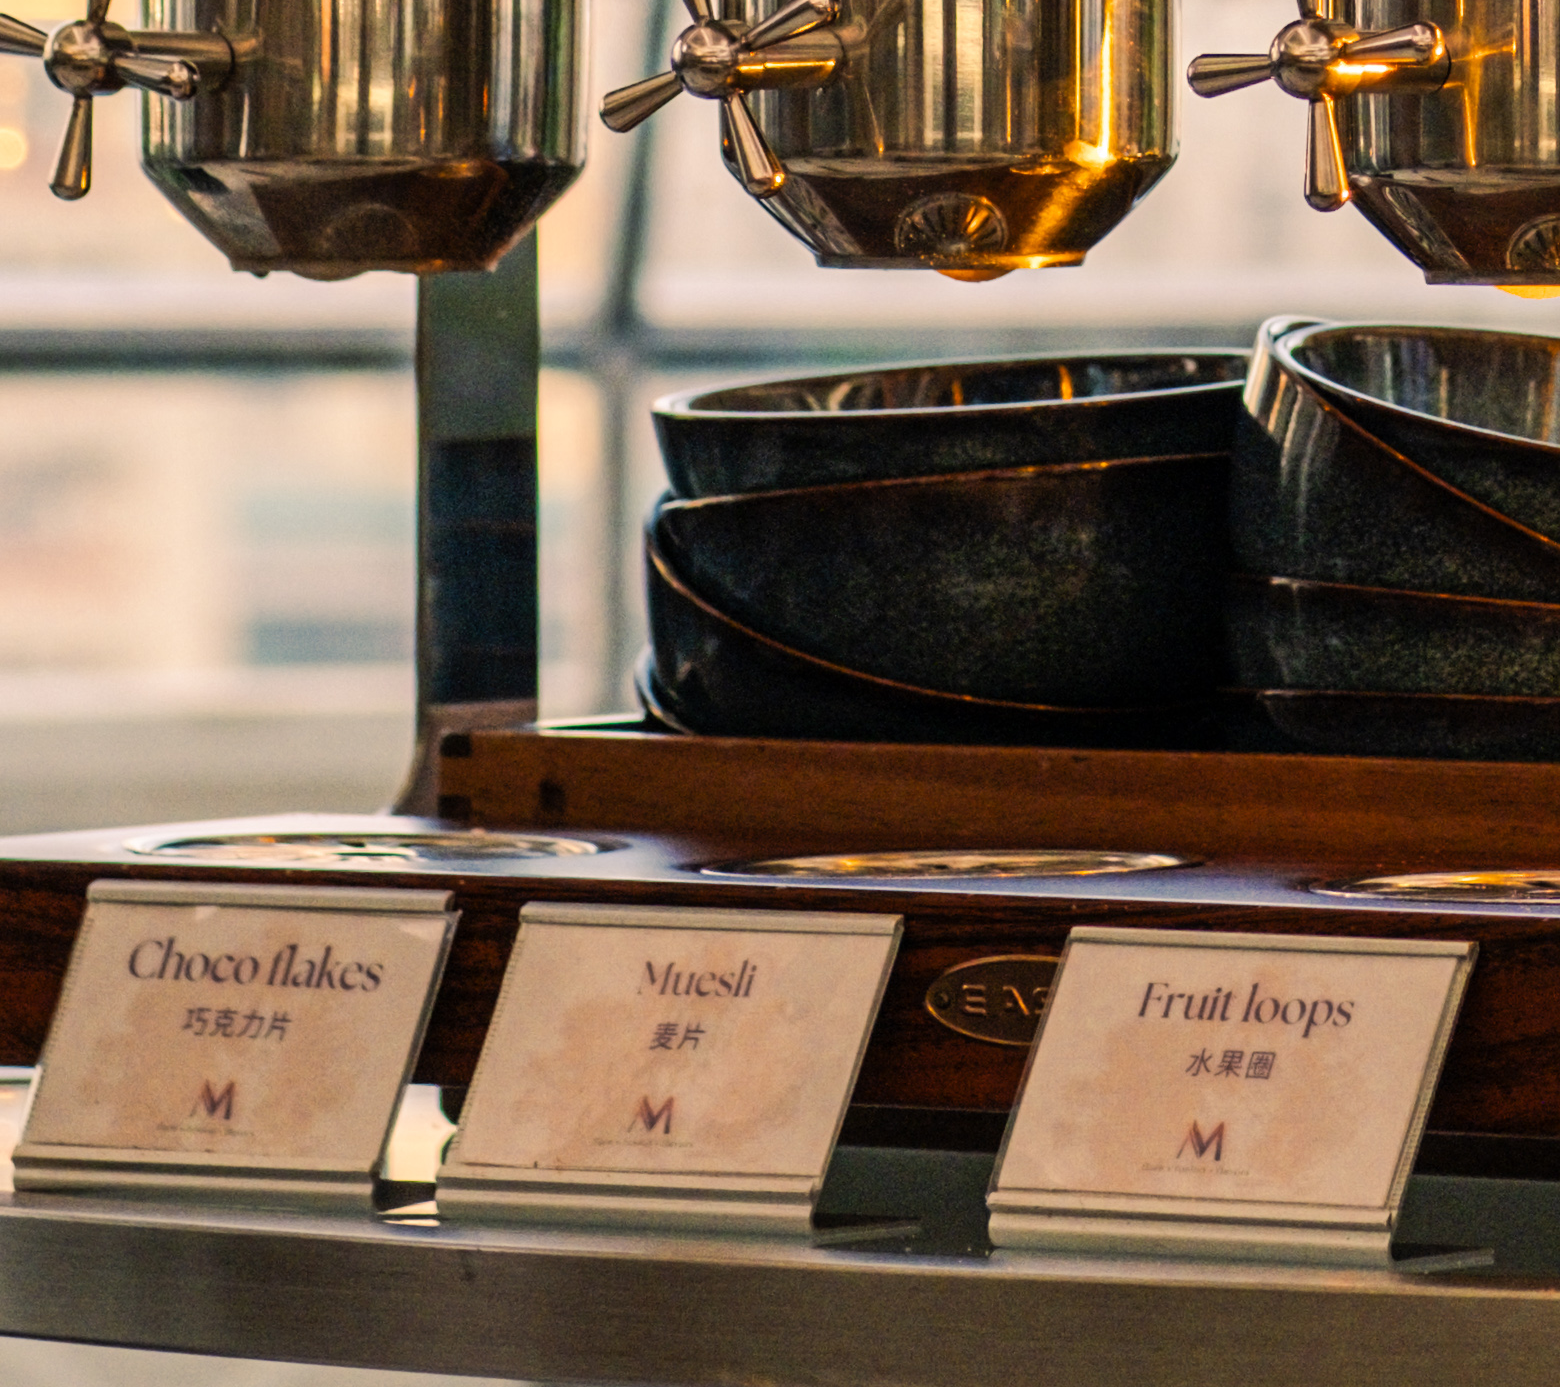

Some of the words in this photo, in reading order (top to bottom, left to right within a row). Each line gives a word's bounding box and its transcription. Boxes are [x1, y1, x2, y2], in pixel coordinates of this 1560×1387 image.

[128, 936, 260, 985] Choco
[266, 943, 384, 993] flakes
[637, 958, 758, 998] Muesli
[182, 1007, 292, 1041] 巧克力片
[1138, 982, 1236, 1022] Fruit
[1241, 982, 1355, 1039] loops
[648, 1021, 707, 1051] 麦片
[1185, 1047, 1277, 1080] 水果圈
